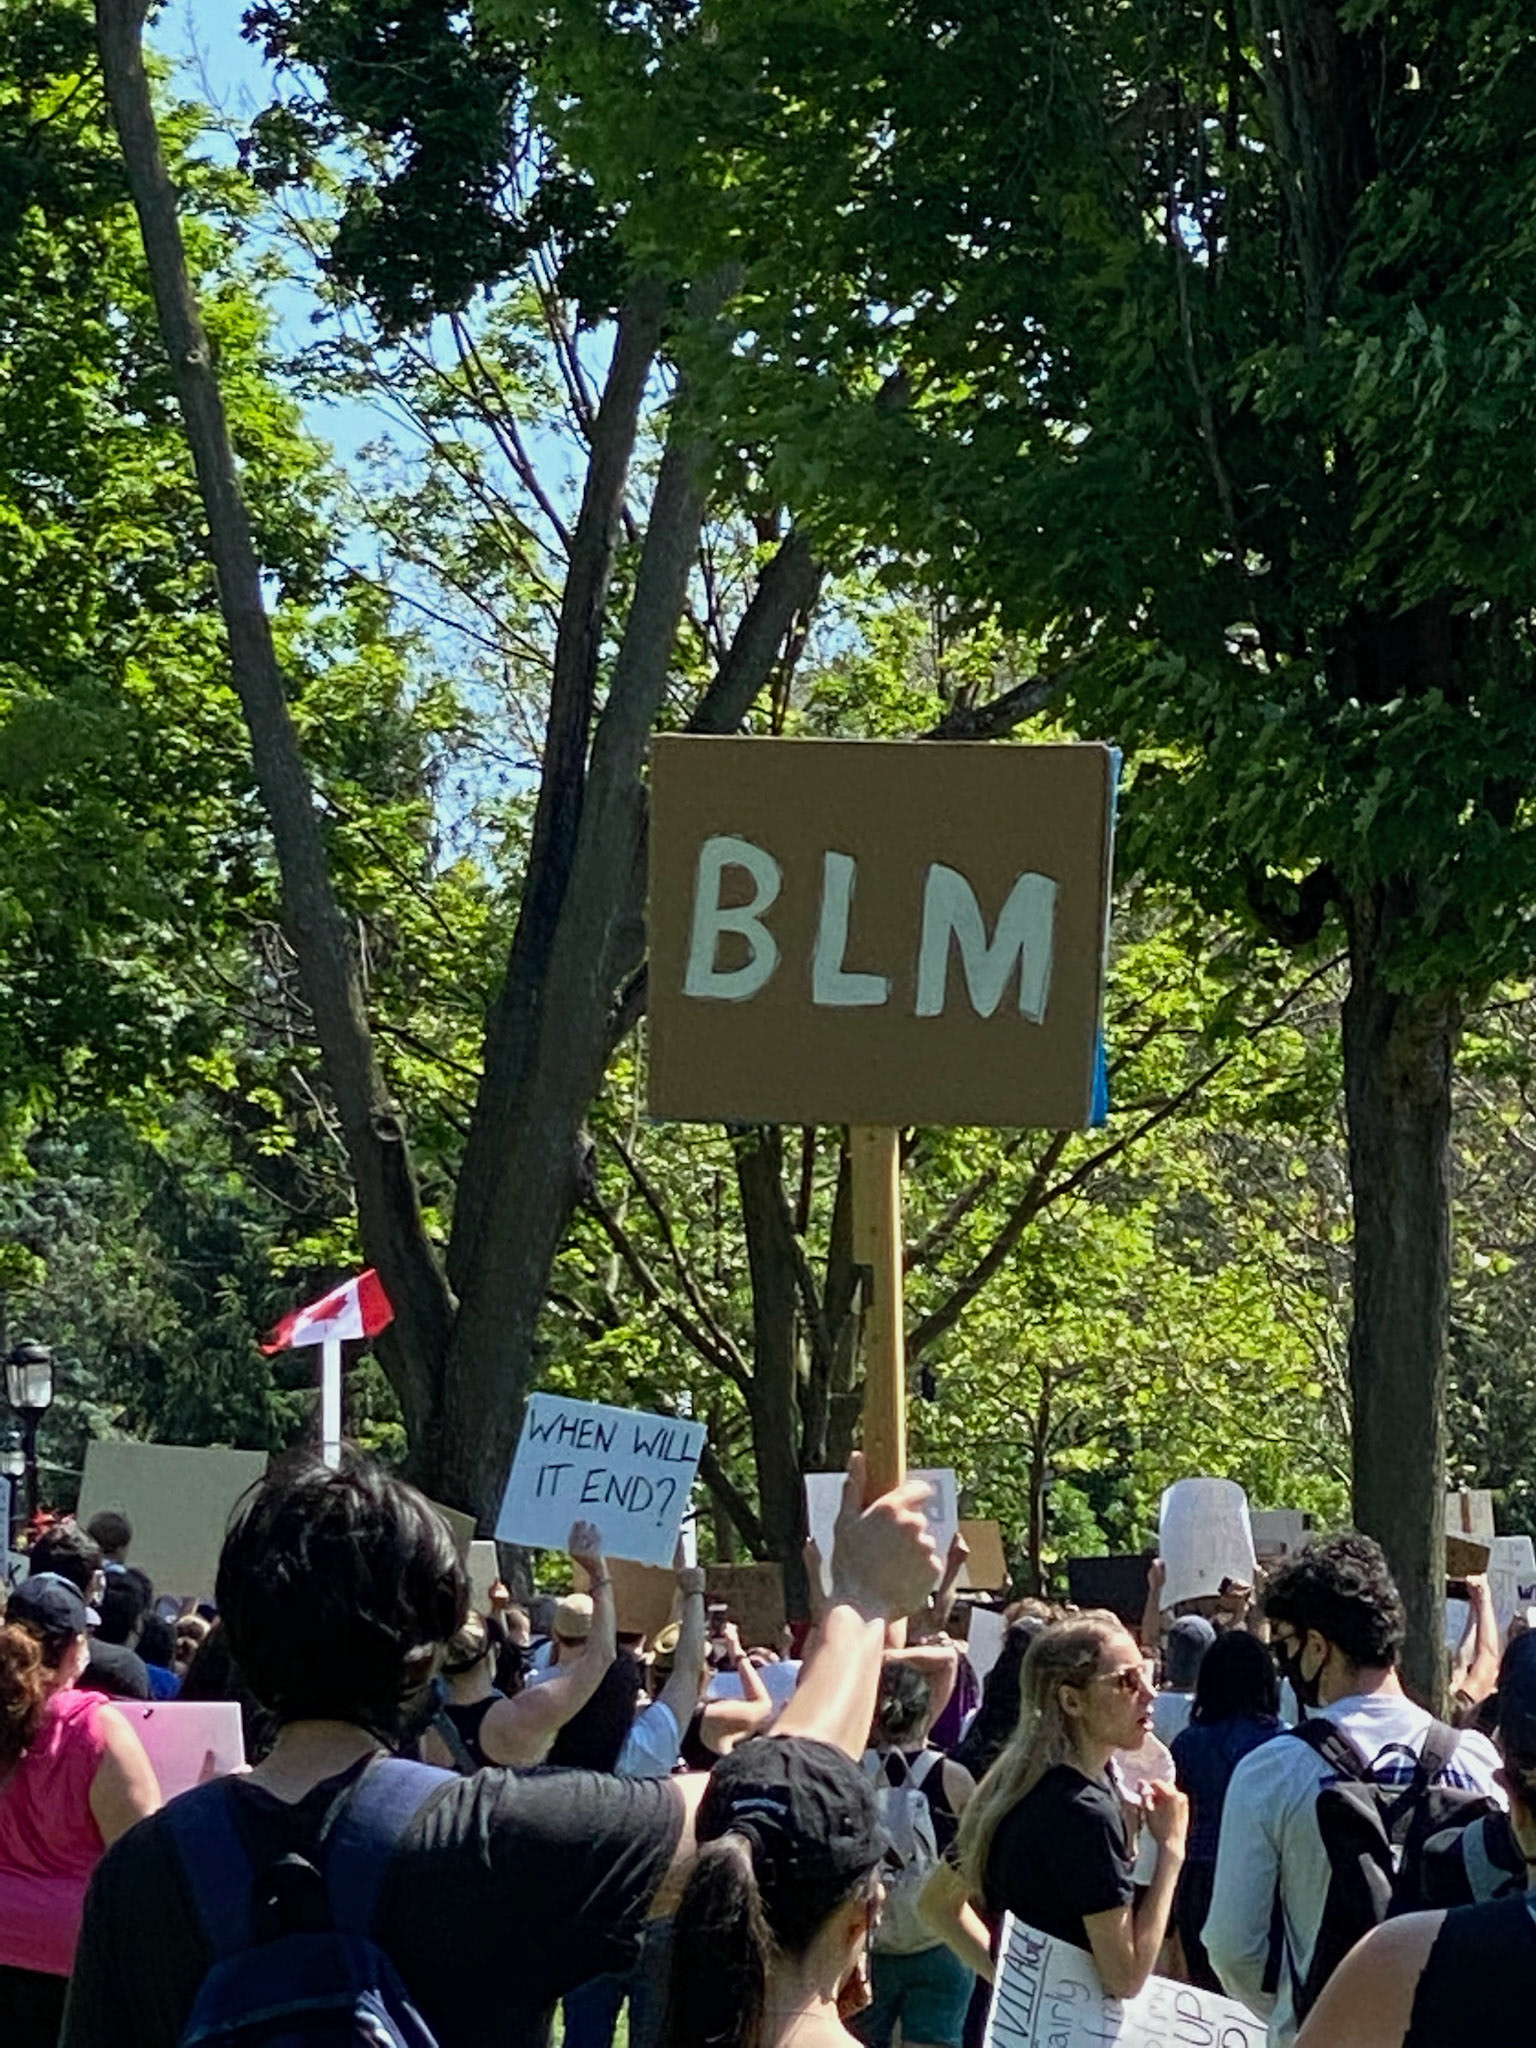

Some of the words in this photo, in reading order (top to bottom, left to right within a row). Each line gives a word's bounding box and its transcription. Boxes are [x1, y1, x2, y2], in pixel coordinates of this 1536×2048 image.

[682, 833, 1058, 1026] BLM
[528, 1408, 619, 1453] WHEN
[633, 1424, 698, 1463] WILL
[535, 1463, 575, 1498] IT
[579, 1468, 677, 1527] END?
[1044, 1979, 1091, 2048] airly
[1173, 1990, 1216, 2047] UP
